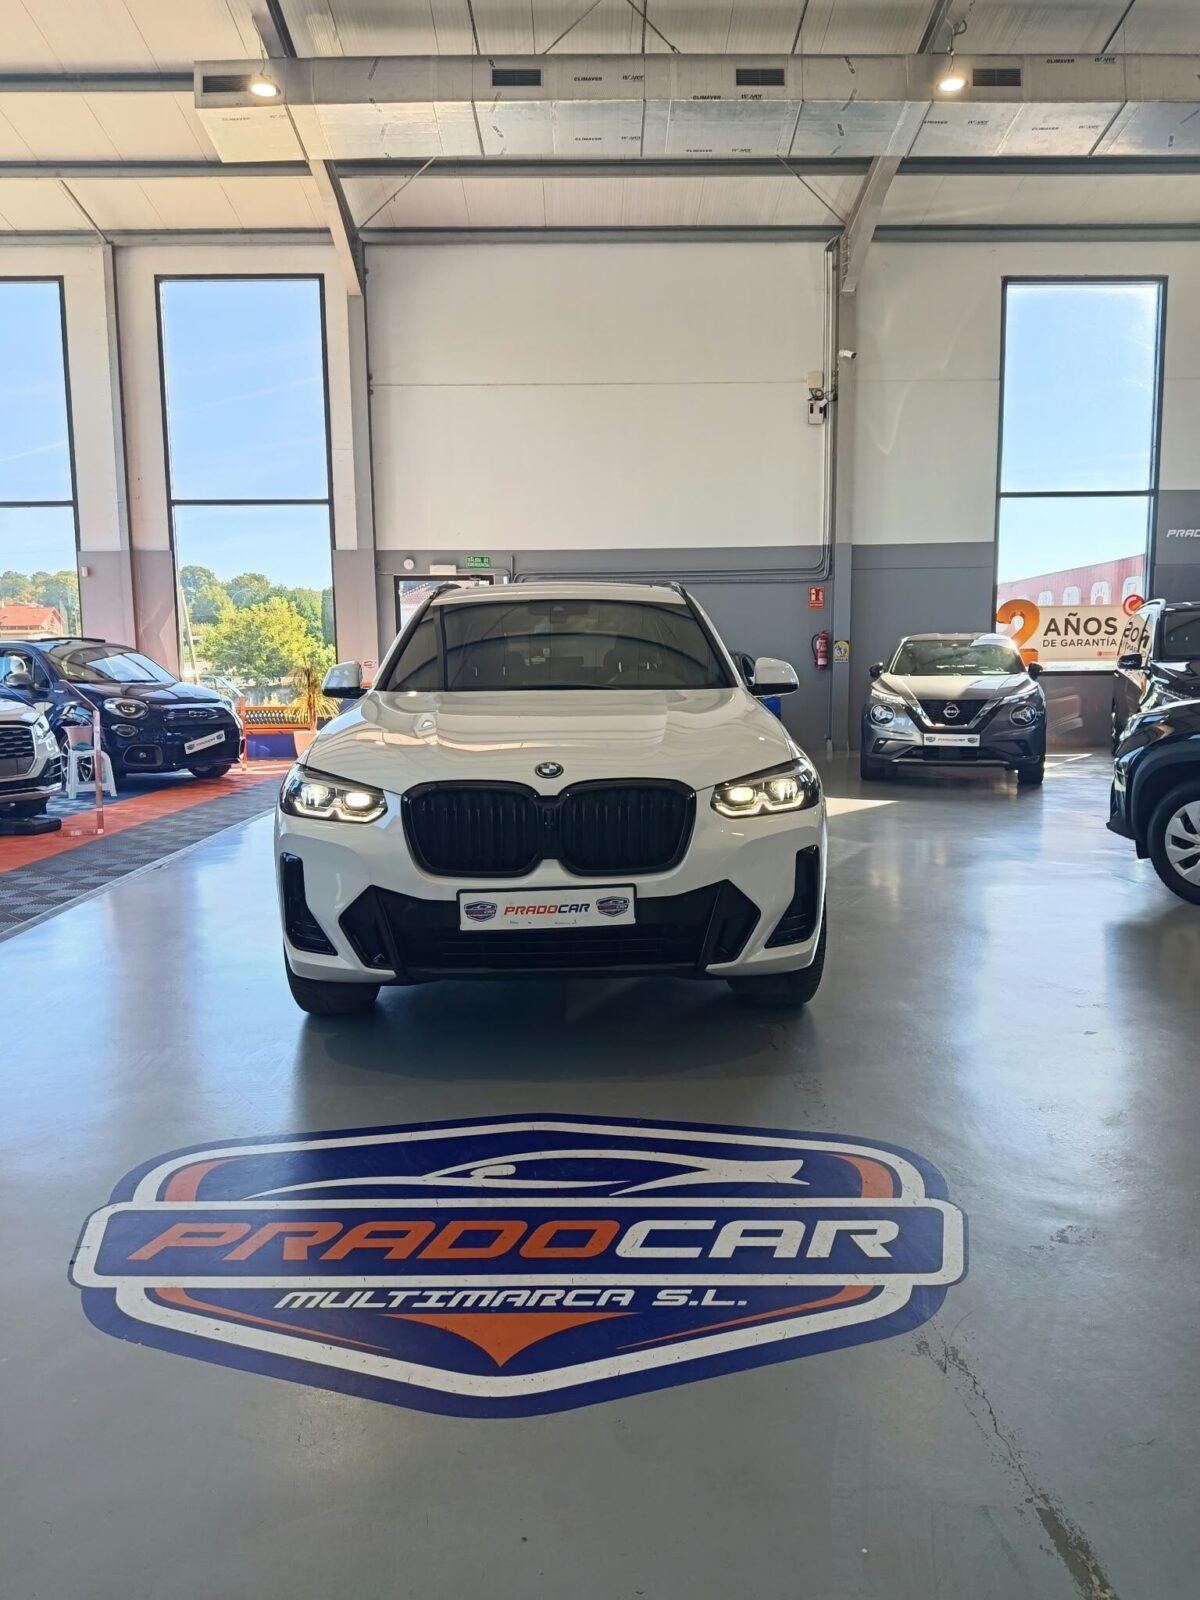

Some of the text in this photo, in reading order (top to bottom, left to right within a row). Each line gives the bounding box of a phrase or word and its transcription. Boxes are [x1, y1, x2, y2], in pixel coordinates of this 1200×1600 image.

[1043, 612, 1118, 636] AÑOS
[1042, 639, 1057, 647] DE
[1060, 636, 1118, 647] GARANTÍA
[504, 903, 590, 915] PRADOCAR
[126, 1220, 900, 1261] PRADOCAR
[273, 1288, 748, 1309] MULTIMARCA S.L.
